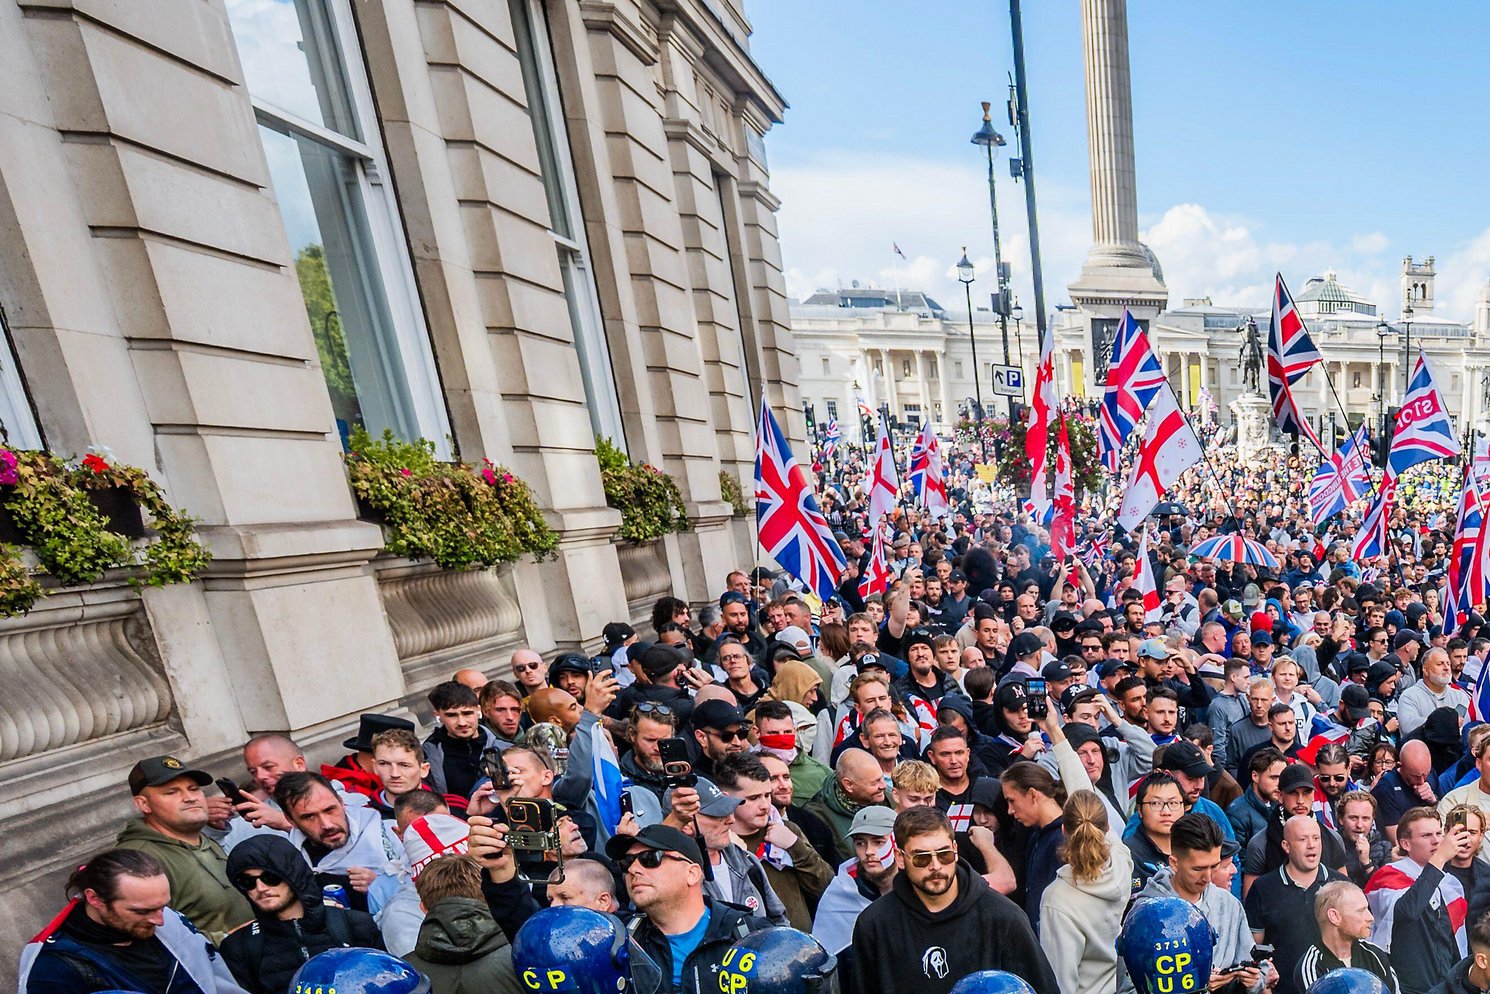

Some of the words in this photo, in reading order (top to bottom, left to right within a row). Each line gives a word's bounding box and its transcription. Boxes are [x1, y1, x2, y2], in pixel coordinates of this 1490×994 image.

[1009, 372, 1018, 386] P
[252, 923, 261, 935] AIR
[1156, 938, 1187, 950] 3731
[1156, 953, 1192, 974] CP
[524, 969, 566, 989] CP
